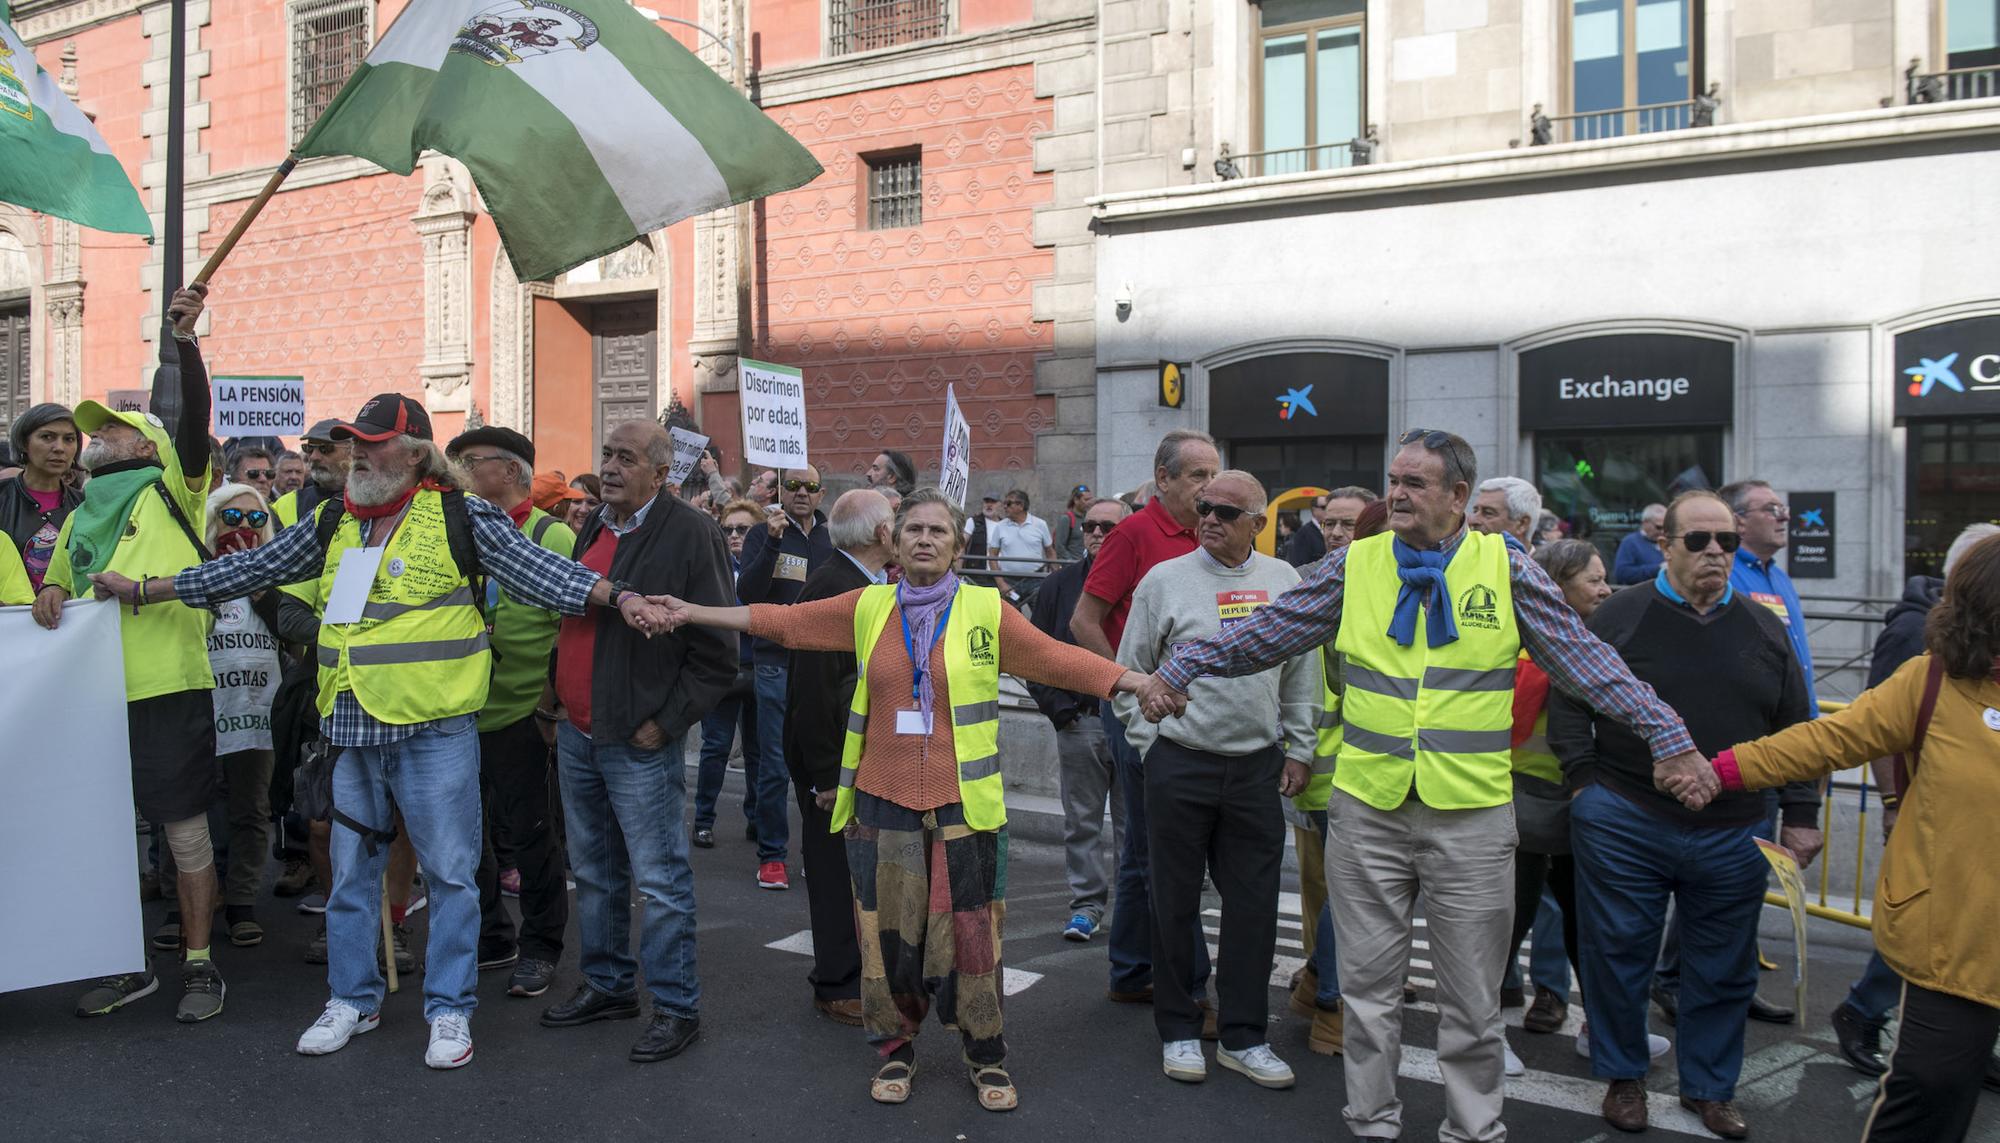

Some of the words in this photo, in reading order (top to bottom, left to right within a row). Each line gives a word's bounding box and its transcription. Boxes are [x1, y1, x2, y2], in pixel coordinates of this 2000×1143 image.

[745, 371, 800, 398] Discrimen
[1559, 375, 1690, 401] Exchange
[219, 386, 237, 402] LA
[241, 384, 304, 406] PENSIÓN,
[219, 411, 234, 426] MI
[238, 411, 304, 426] DERECHO!
[747, 405, 765, 424] por
[768, 405, 802, 430] edad,
[749, 435, 776, 453] nunca
[779, 435, 804, 456] más.
[1798, 544, 1826, 554] Store
[206, 632, 277, 652] ENSIONES
[214, 670, 268, 689] IGNAS
[216, 714, 272, 734] ÓRDBA
